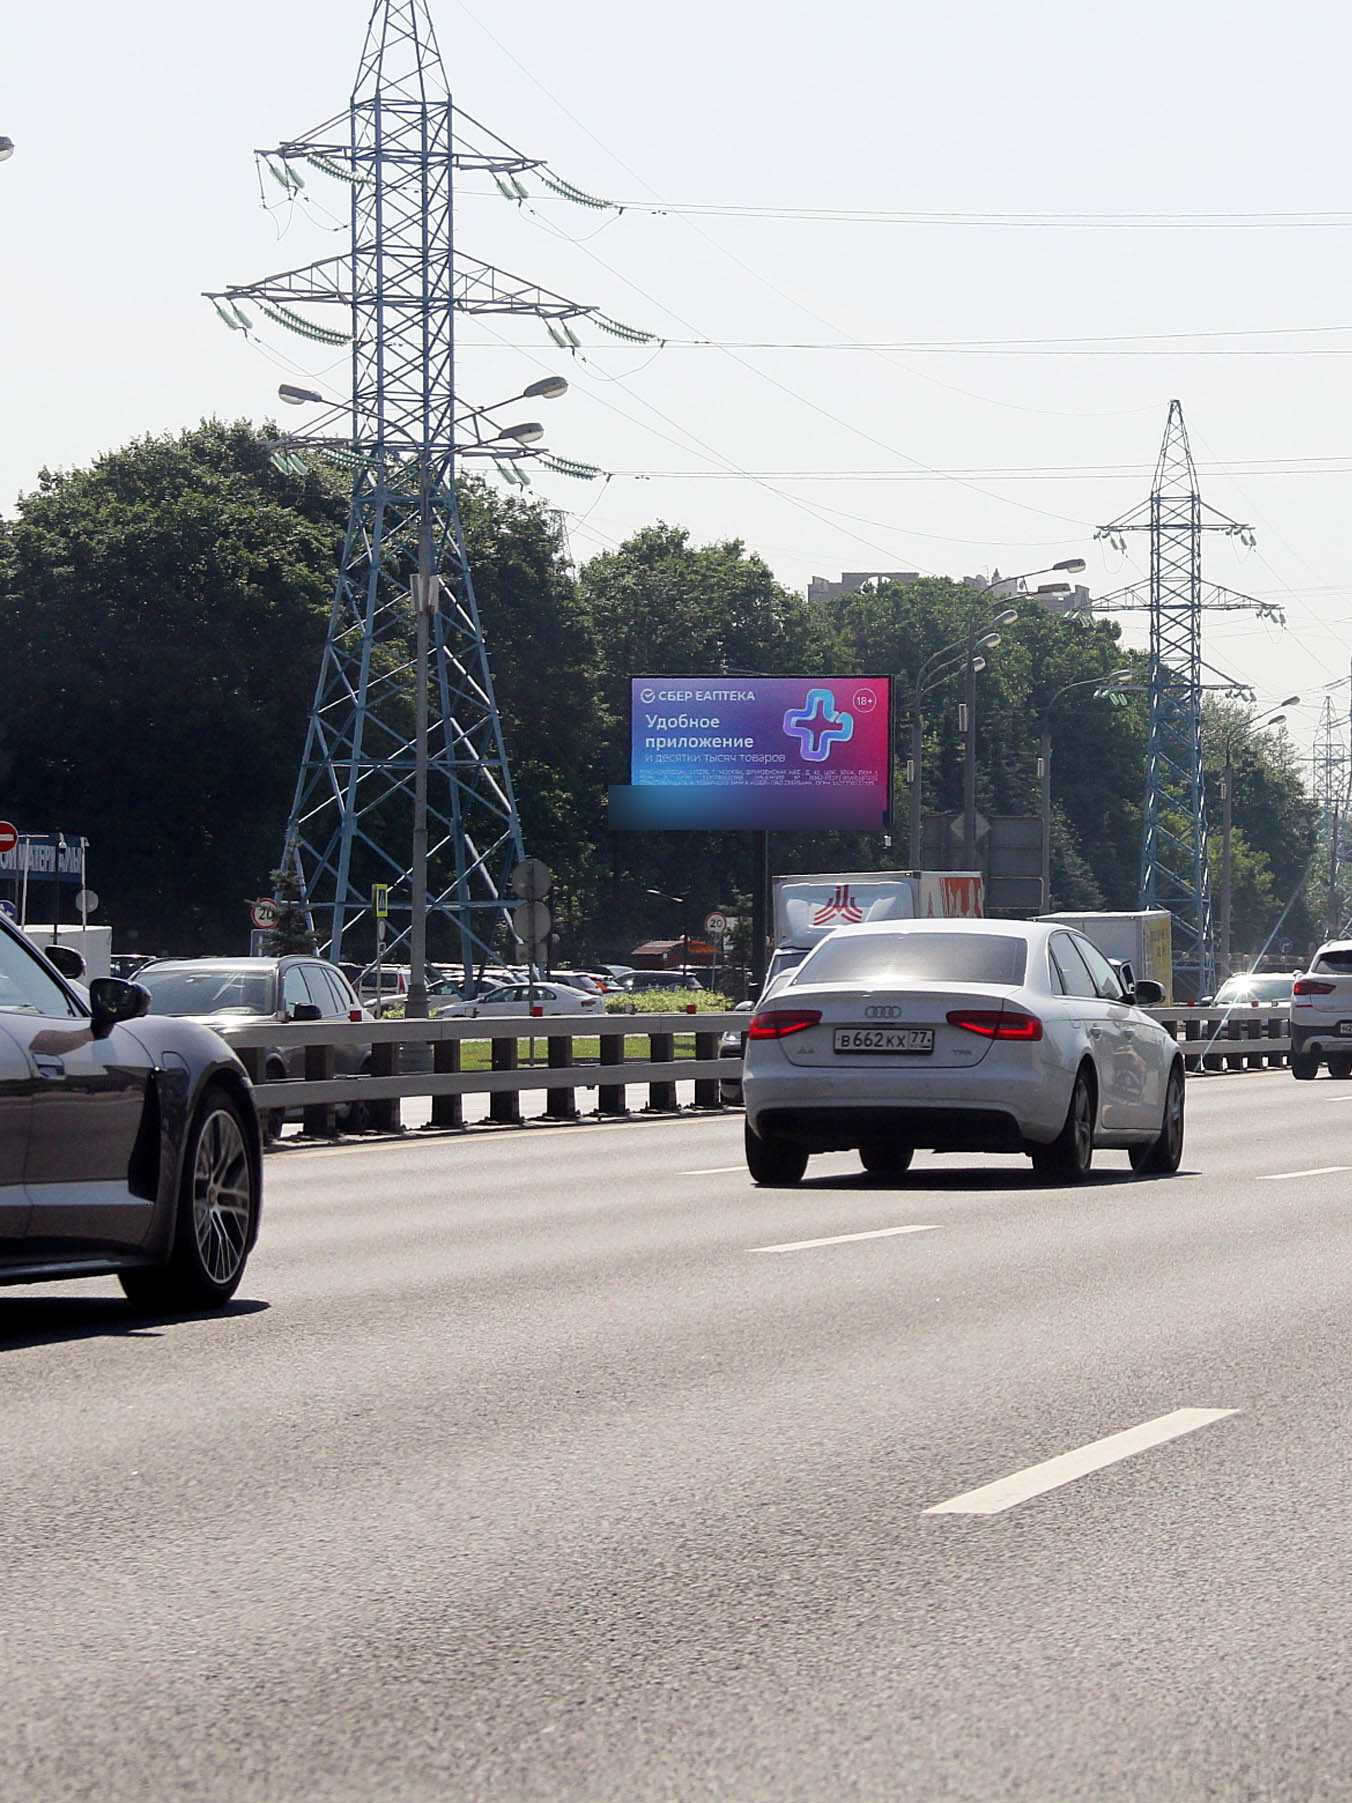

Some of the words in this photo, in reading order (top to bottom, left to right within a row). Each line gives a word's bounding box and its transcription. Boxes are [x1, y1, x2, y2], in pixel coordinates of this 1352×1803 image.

[658, 690, 693, 701] СБЕР
[695, 690, 756, 701] ЕАПТЕКА
[856, 696, 873, 705] 18+
[645, 714, 720, 730] Удобное
[645, 737, 754, 751] приложение
[645, 754, 652, 762] и
[655, 754, 701, 763] десятки
[703, 754, 737, 762] тысяч
[739, 754, 786, 764] товаров
[710, 919, 722, 928] 20
[841, 1031, 906, 1048] В662КХ
[911, 1031, 928, 1043] 77
